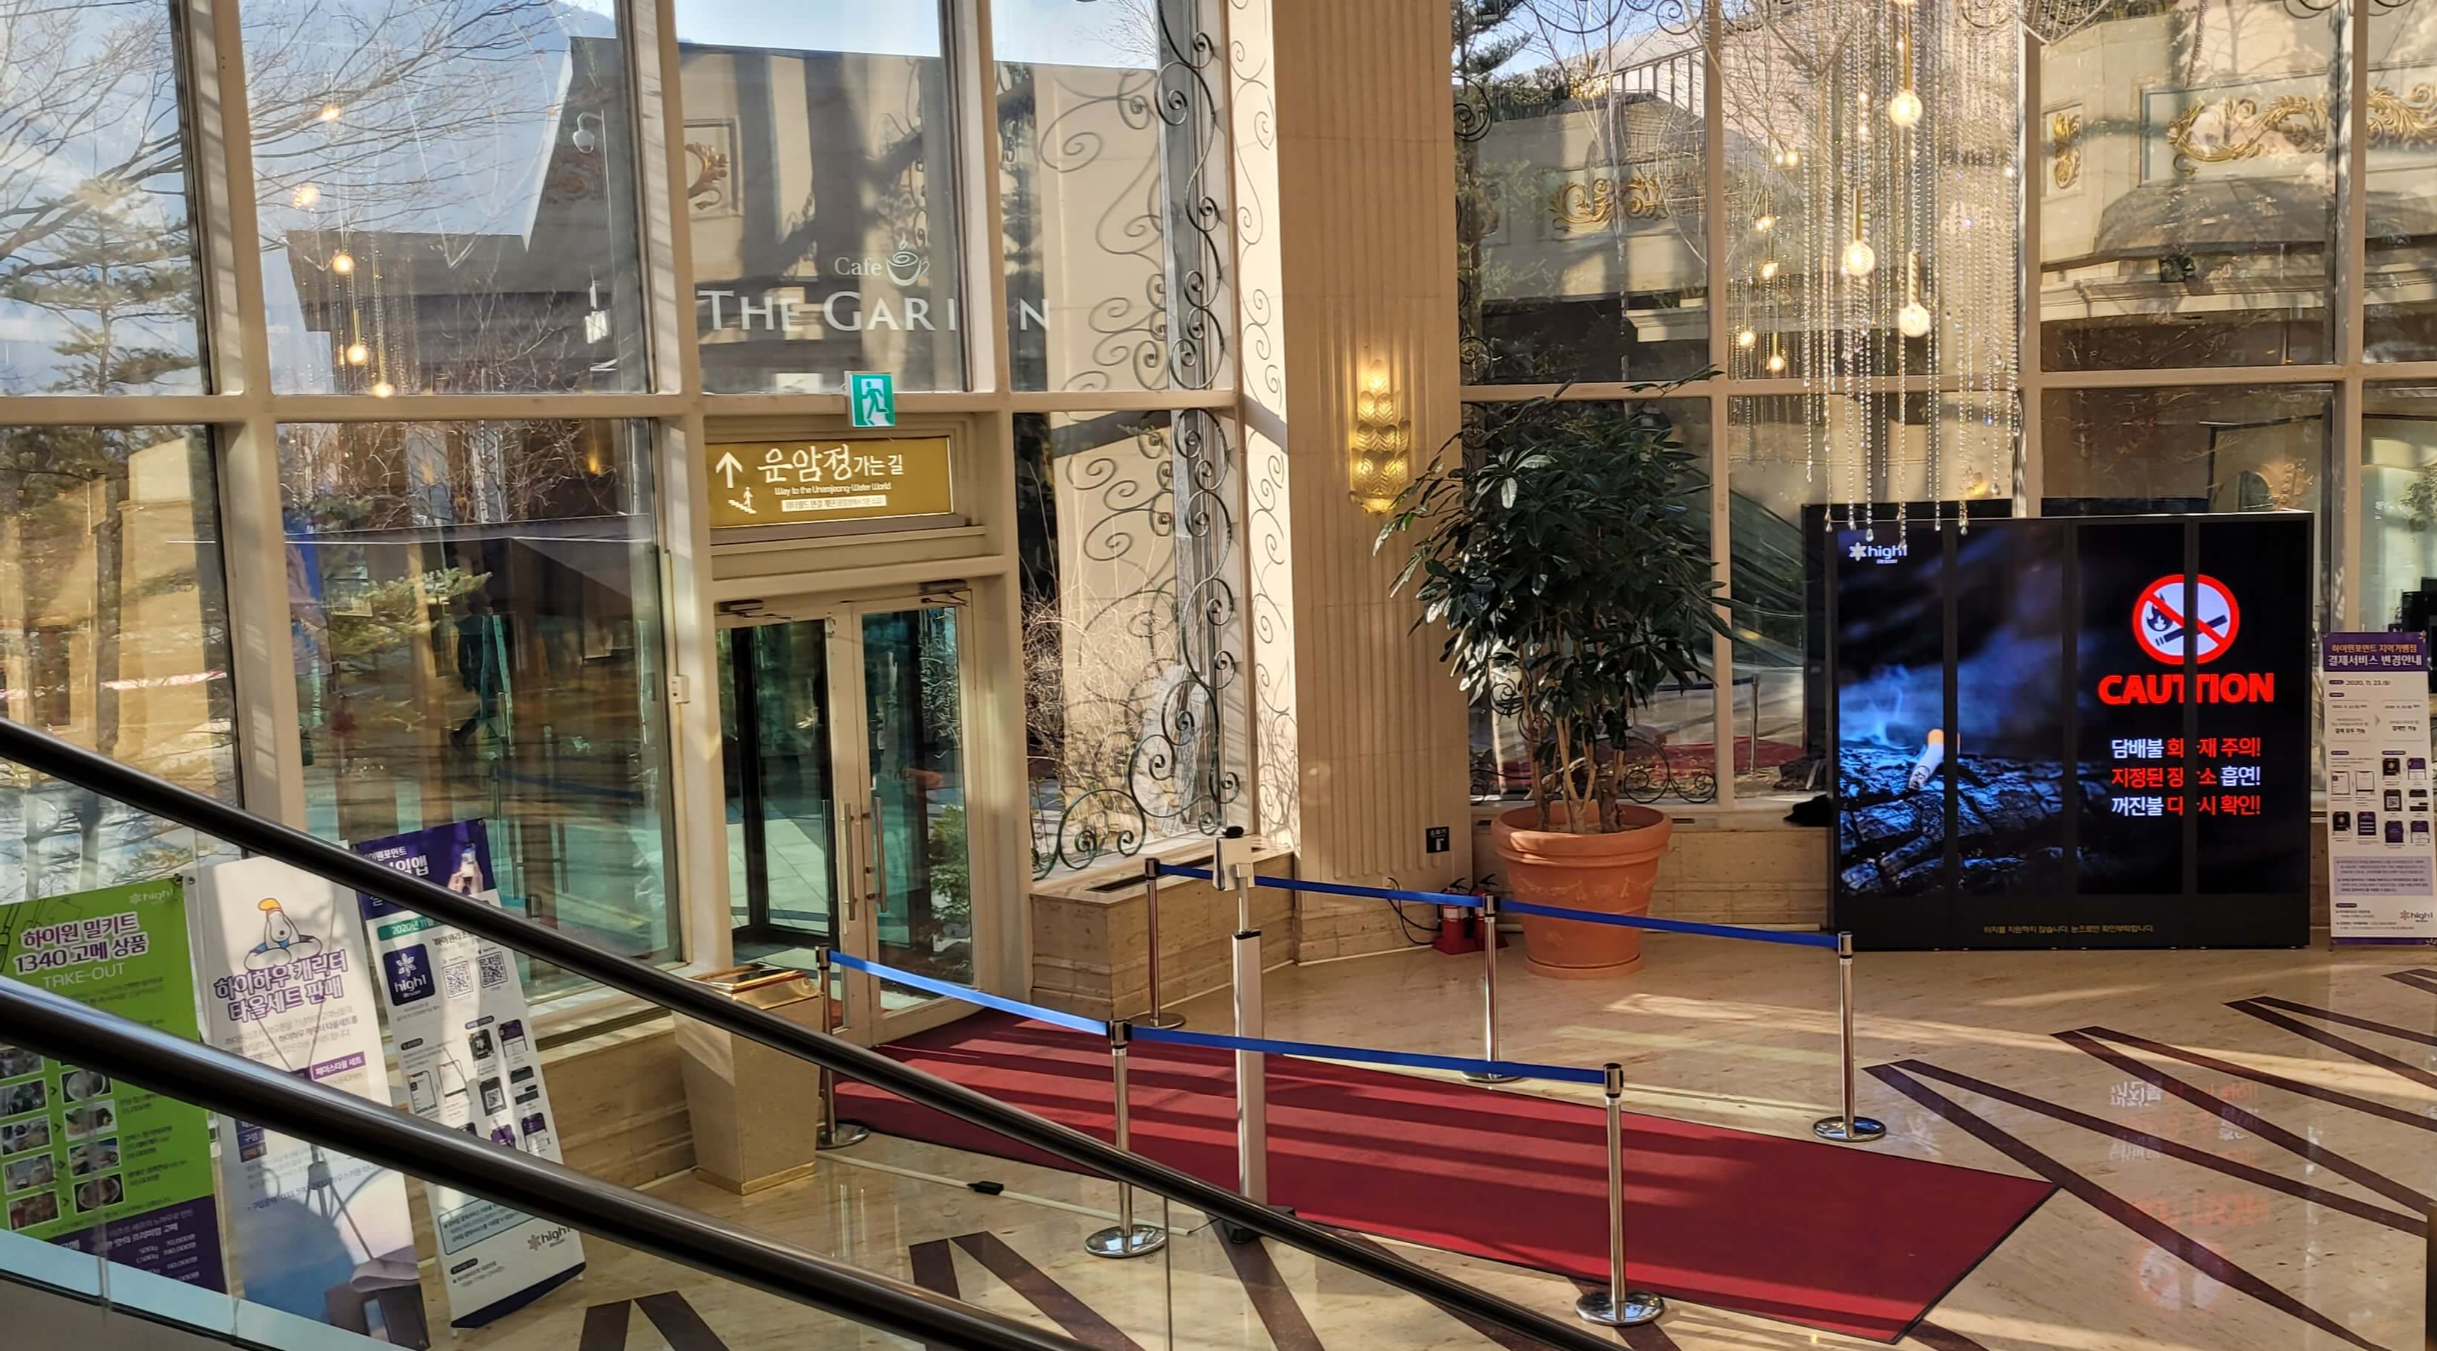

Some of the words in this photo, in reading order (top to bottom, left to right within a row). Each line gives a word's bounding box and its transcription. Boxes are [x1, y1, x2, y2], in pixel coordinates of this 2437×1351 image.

[834, 256, 882, 276] Cafe
[697, 289, 801, 332] THE
[757, 443, 853, 483] 운암정
[2328, 655, 2379, 666] 결제서비스
[2381, 655, 2422, 666] 변경안내
[2098, 672, 2275, 705] CAUTION
[2111, 738, 2164, 759] 담배불
[2220, 737, 2261, 757] 주의!
[2111, 767, 2164, 788] 지정된
[2220, 766, 2261, 786] 흡연!
[2111, 796, 2164, 817] 꺼진불
[2220, 795, 2261, 816] 확인!
[23, 922, 80, 948] 하이원
[83, 912, 138, 940] 밀키트
[15, 949, 67, 973] 1340
[72, 941, 108, 963] 고메
[112, 933, 147, 957] 상품
[292, 948, 348, 981] 캐릭터
[43, 962, 125, 989] TAKE-OUT
[228, 986, 304, 1023] 타올세트
[305, 974, 344, 1005] 판매
